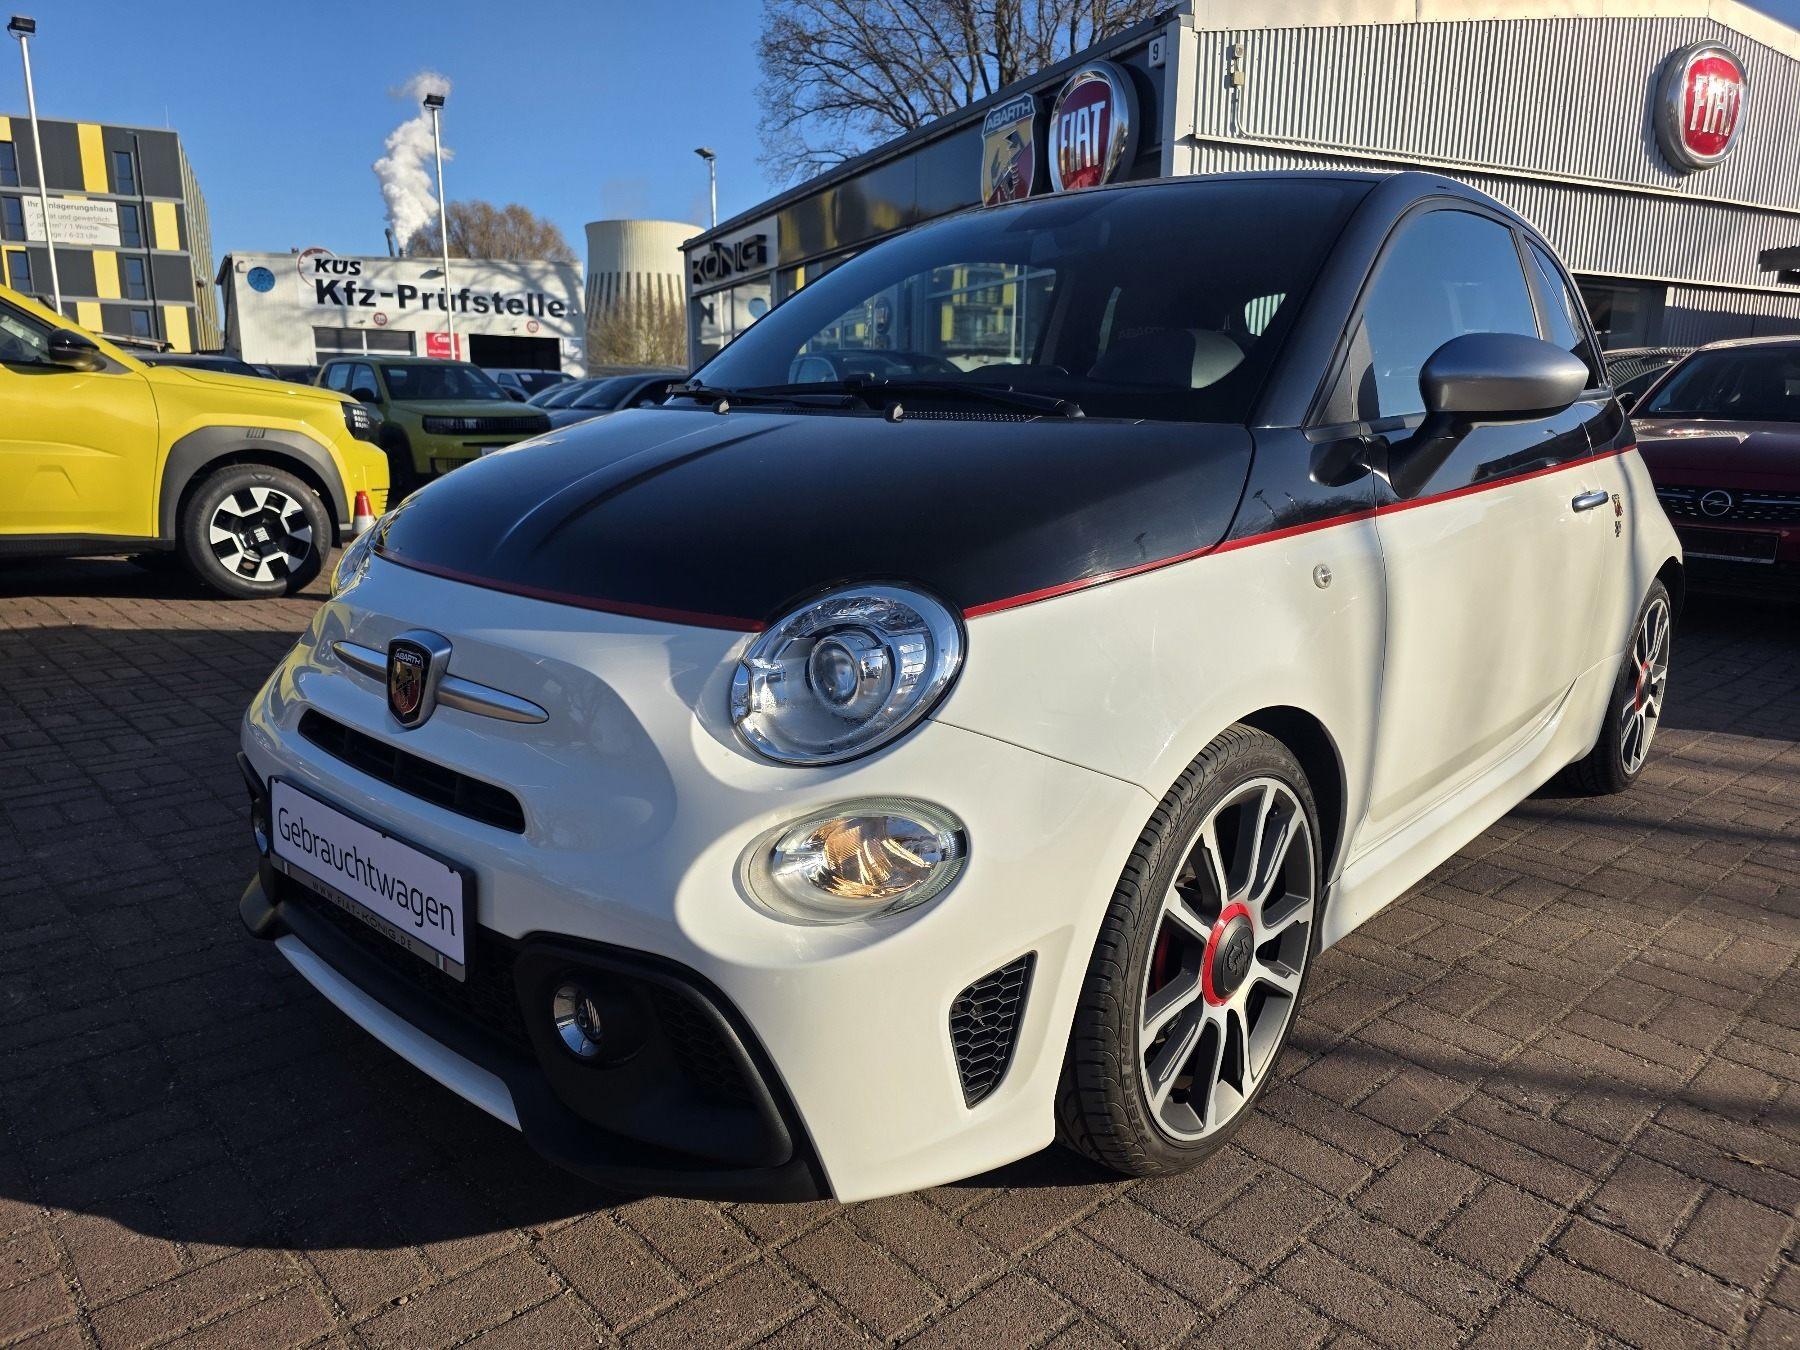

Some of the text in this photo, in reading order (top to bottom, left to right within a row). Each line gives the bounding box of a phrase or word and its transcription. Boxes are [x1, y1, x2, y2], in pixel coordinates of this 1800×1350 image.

[1152, 42, 1160, 62] 9
[984, 100, 1032, 132] ABARTH
[1690, 74, 1740, 137] FIAT
[1060, 100, 1106, 177] FIAT
[47, 202, 114, 213] nlagerungshaus
[314, 258, 362, 276] KÜS
[692, 233, 768, 286] KÖNIG
[314, 278, 566, 319] Kfz-Prüfstelle
[395, 652, 421, 665] ABARTH
[277, 807, 457, 938] Gebrauchtwagen
